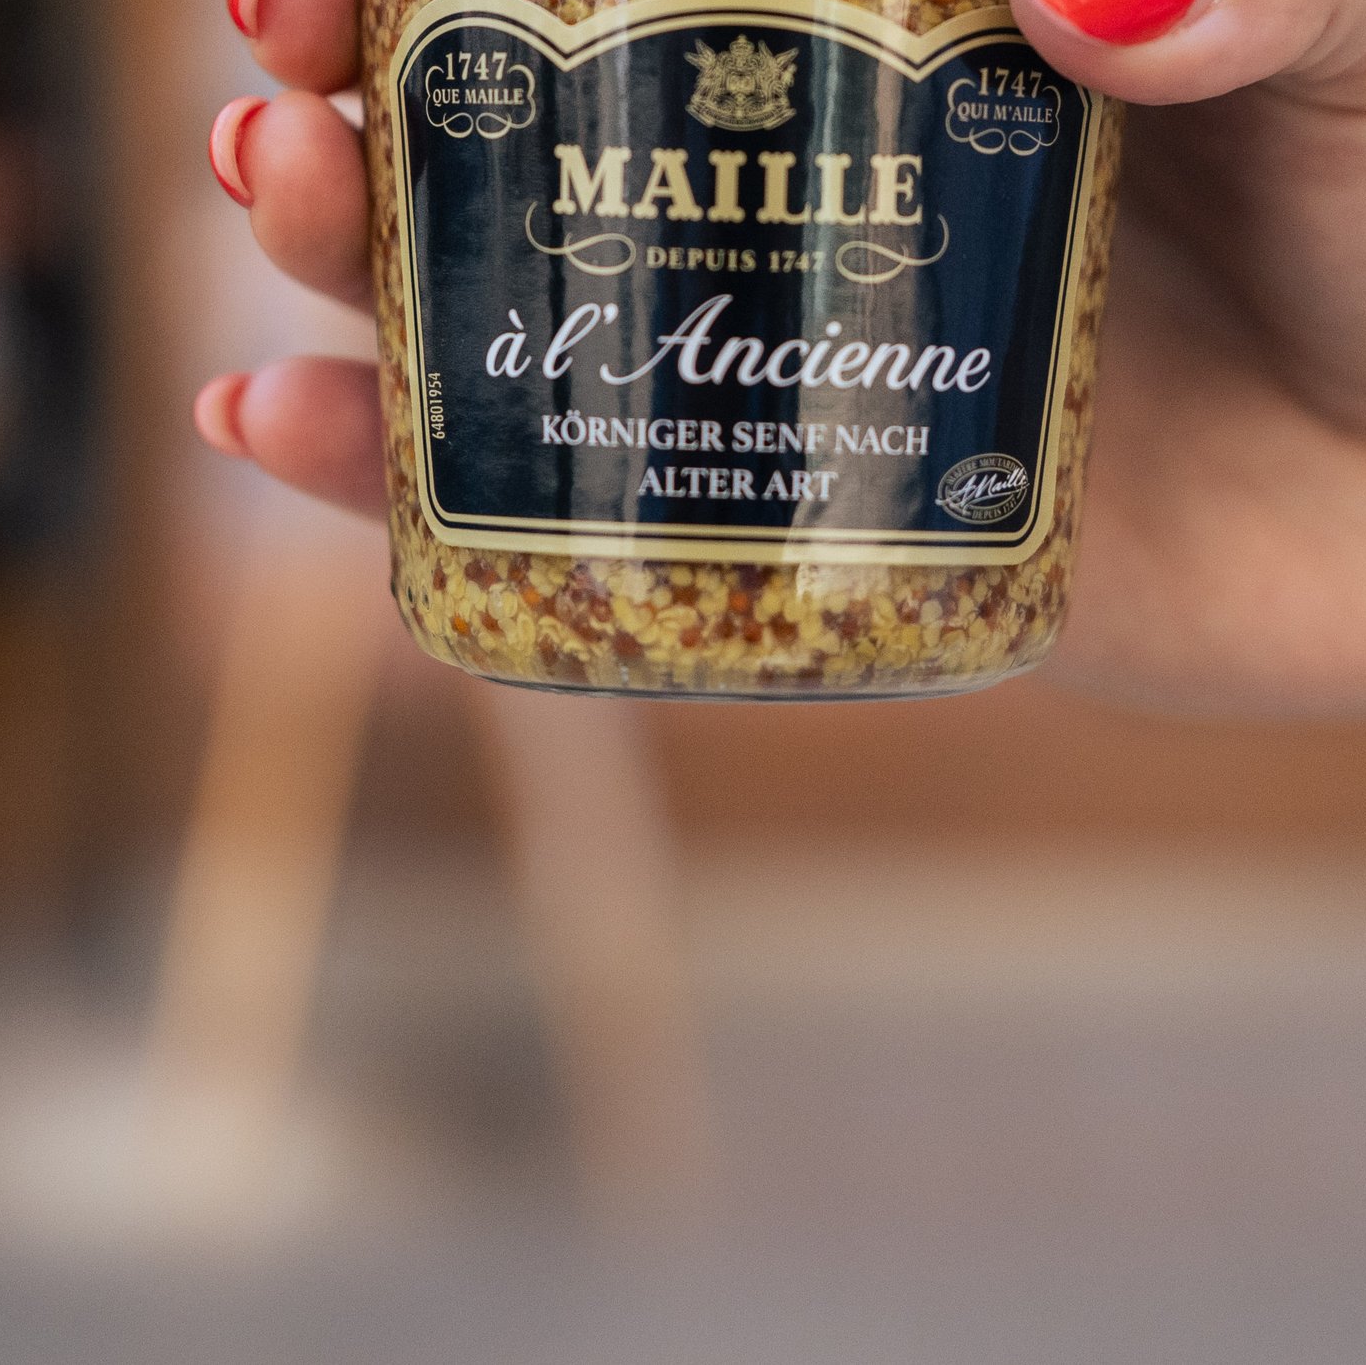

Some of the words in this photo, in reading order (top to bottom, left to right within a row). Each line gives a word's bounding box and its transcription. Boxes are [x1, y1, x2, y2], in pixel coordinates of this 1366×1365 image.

[445, 51, 508, 81] 1747
[432, 88, 460, 107] QUE
[464, 88, 524, 105] MAILLE
[978, 67, 1042, 99] 1747
[957, 101, 989, 122] QUI
[993, 105, 1053, 123] M'AILLE
[553, 144, 923, 226] MAILLE
[646, 246, 757, 272] DEPUIS
[768, 250, 826, 273] 1747
[485, 308, 531, 378] à
[428, 372, 446, 440] 64801954
[541, 409, 725, 452] KÖRNIGER
[732, 421, 827, 454] SENF
[834, 424, 930, 455] NACH
[637, 466, 756, 499] ALTER
[765, 469, 838, 501] ART
